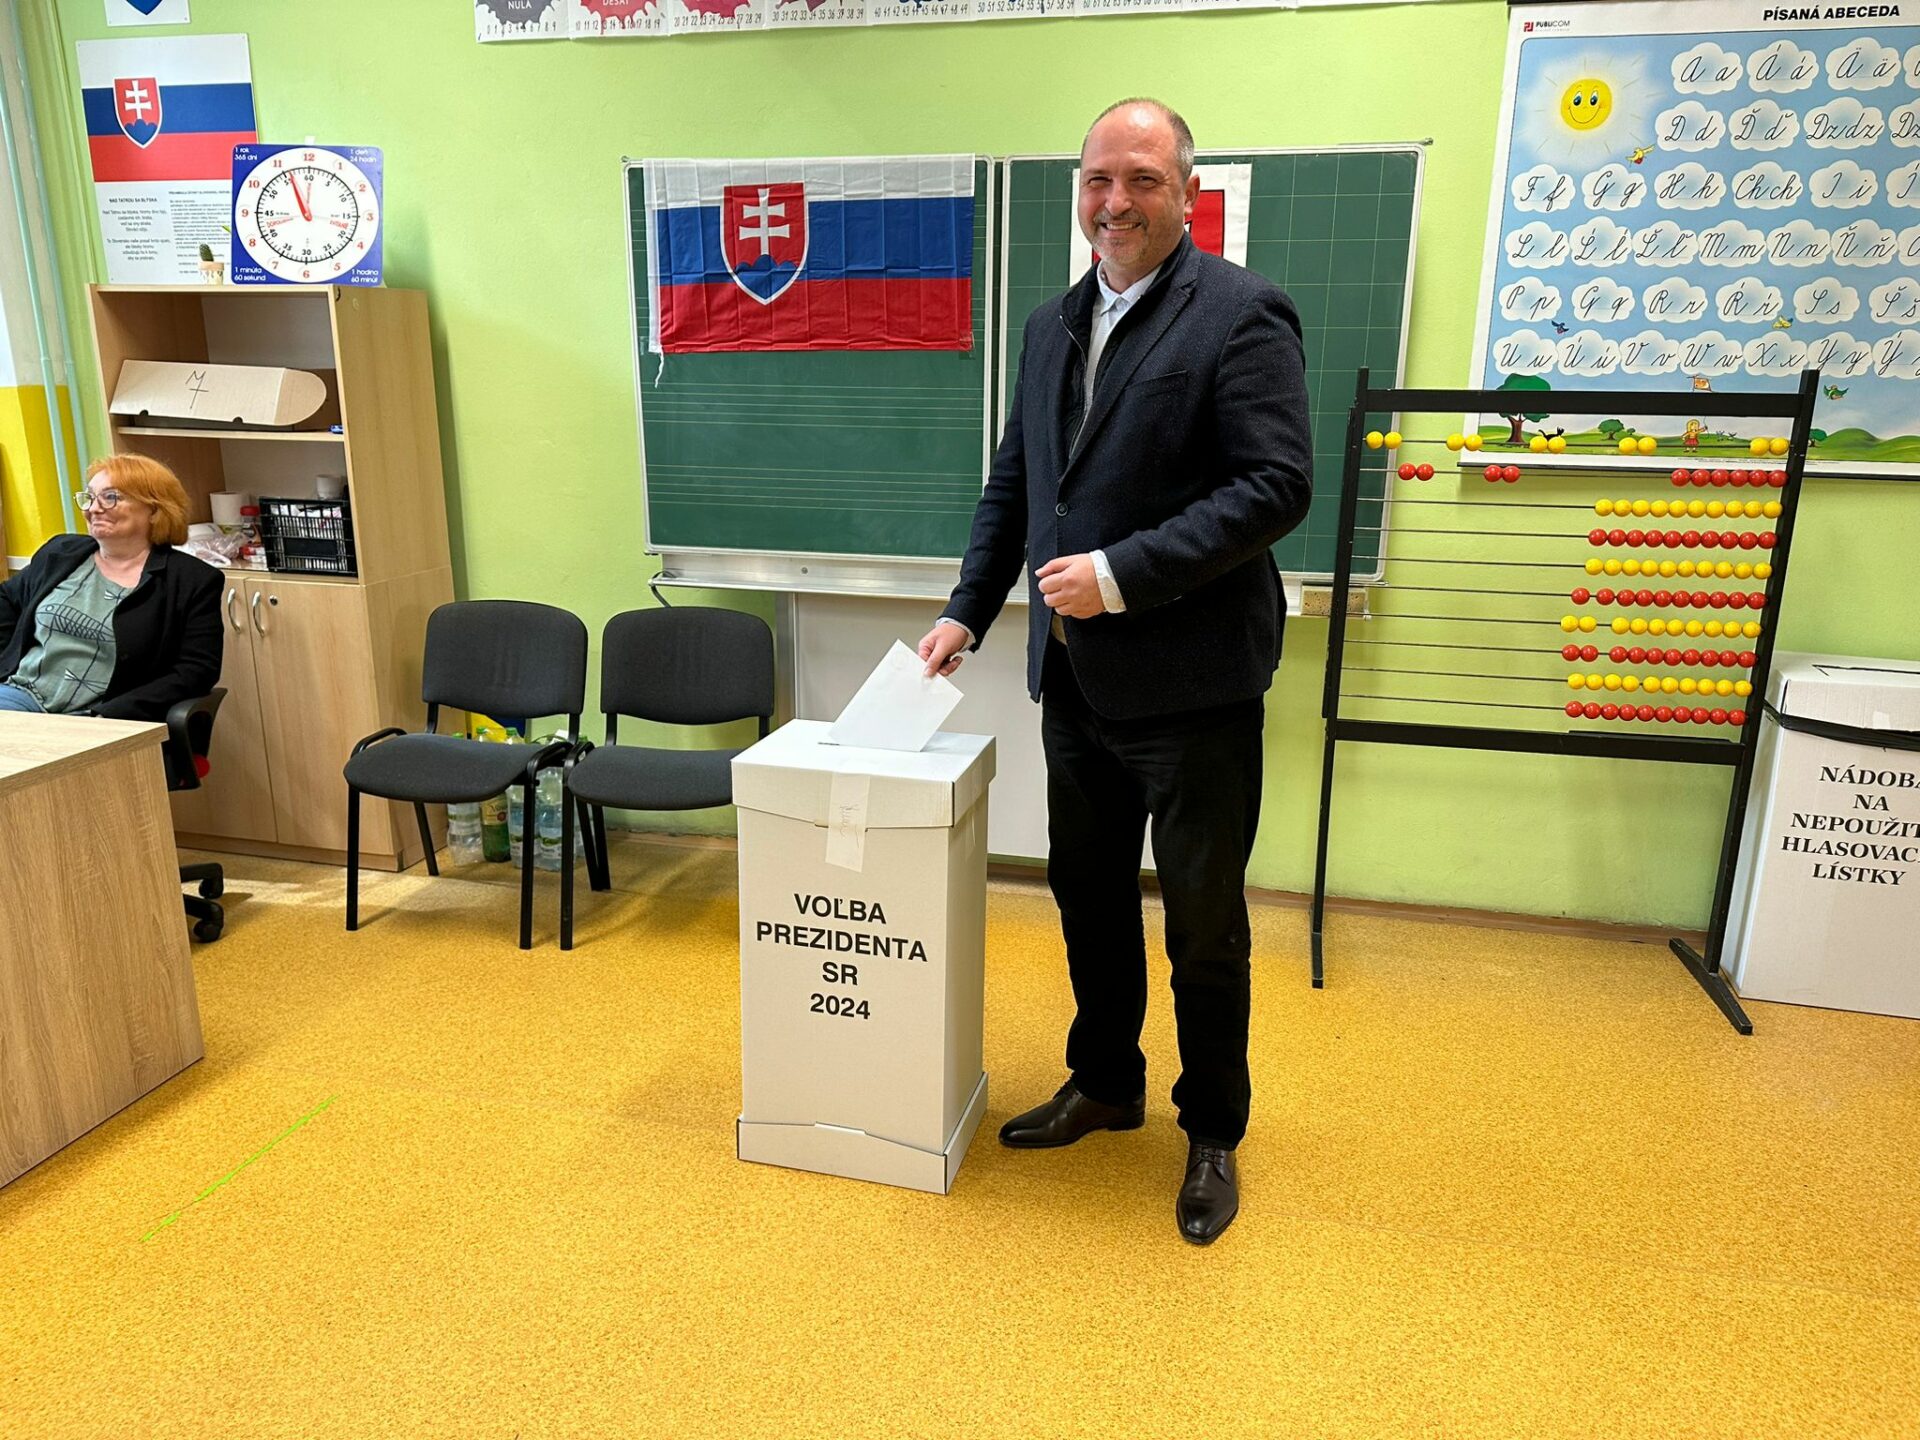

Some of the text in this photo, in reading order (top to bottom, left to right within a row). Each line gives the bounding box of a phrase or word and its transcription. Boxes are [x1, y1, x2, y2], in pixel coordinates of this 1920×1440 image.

[508, 0, 532, 9] NULA
[1763, 4, 1900, 21] PÍSANÁ ABECEDA
[1681, 56, 1706, 82] A
[1715, 67, 1738, 81] a
[304, 153, 314, 162] 12
[273, 160, 282, 168] 11
[338, 162, 342, 170] 1
[248, 180, 260, 188] 10
[359, 183, 366, 192] 2
[269, 190, 278, 199] 50
[339, 194, 347, 203] 10
[241, 209, 249, 218] 9
[367, 213, 374, 221] 3
[249, 238, 256, 247] 8
[282, 243, 292, 251] 35
[357, 241, 364, 250] 4
[272, 262, 278, 270] 7
[334, 262, 340, 271] 5
[303, 270, 310, 279] 6
[1852, 793, 1890, 812] NA
[1790, 812, 1920, 839] NEPOUŽIT
[1781, 836, 1920, 864] HLASOVAC
[1812, 861, 1907, 886] LÍSTKY
[793, 893, 887, 925] VOĽBA
[755, 921, 928, 962] PREZIDENTA
[821, 961, 858, 986] SR
[809, 993, 871, 1020] 2024
